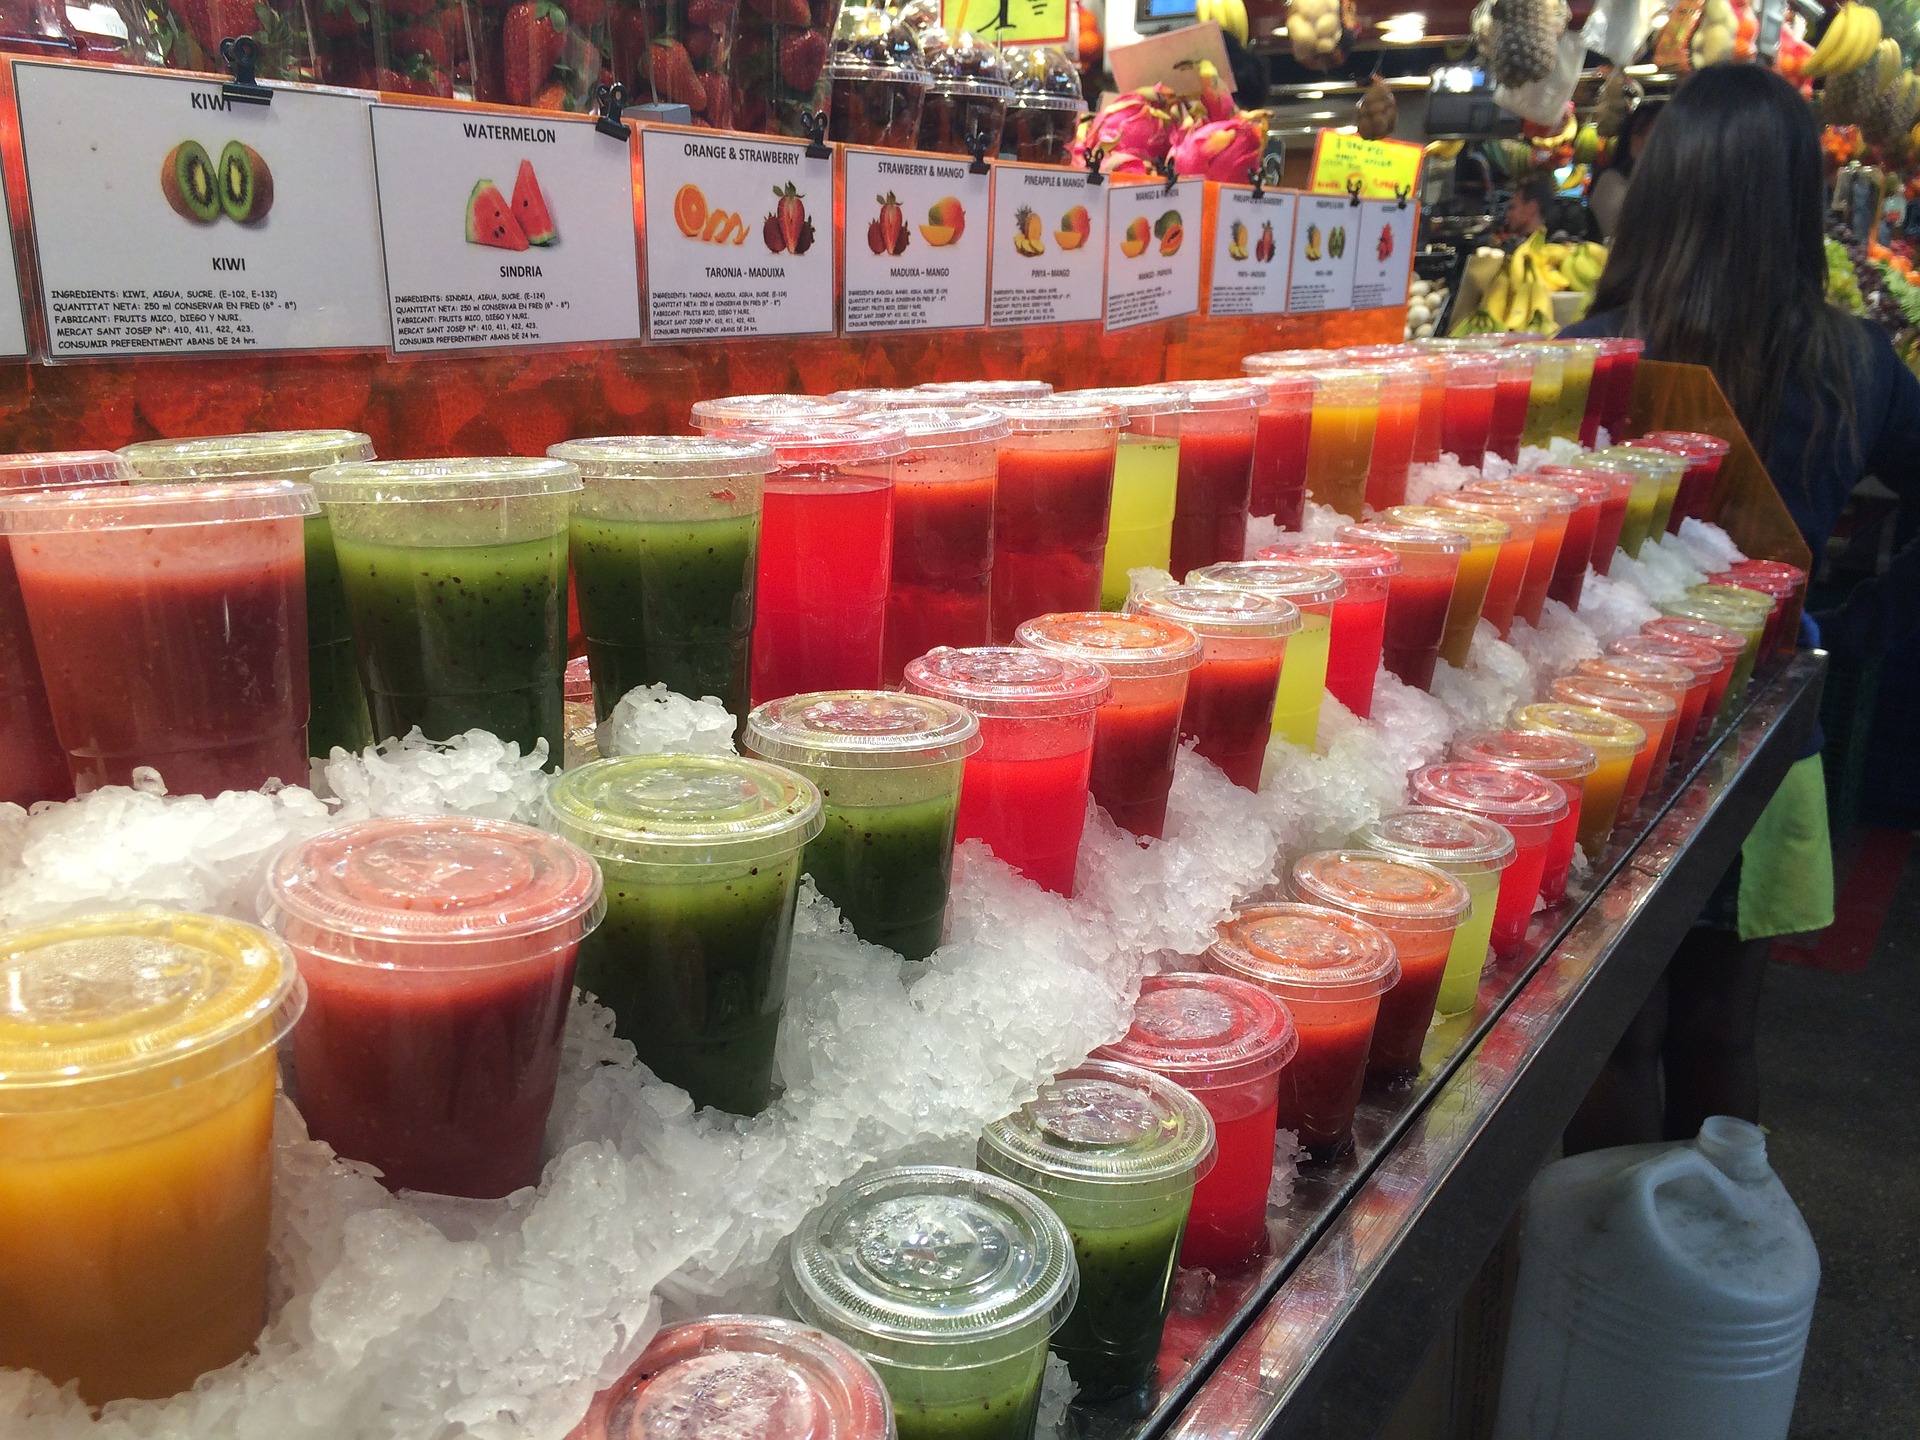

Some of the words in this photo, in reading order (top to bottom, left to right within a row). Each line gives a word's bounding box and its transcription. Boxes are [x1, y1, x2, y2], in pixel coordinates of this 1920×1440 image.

[464, 123, 556, 143] WATERMELON
[684, 143, 727, 160] ORANGE
[728, 148, 737, 160] &
[739, 149, 800, 166] STRAWBERRY
[878, 161, 928, 176] STRAWBERRY
[928, 165, 935, 177] &
[936, 166, 964, 179] MANGO
[212, 257, 246, 272] KIWI
[500, 265, 543, 278] SINDRIA
[705, 267, 742, 279] TARONJA
[748, 267, 785, 279] MADUIXA
[890, 268, 920, 277] MADUIXA
[926, 268, 950, 277] MANGO
[52, 290, 119, 299] INGREDIENTS:
[123, 290, 149, 299] KIWI,
[153, 290, 183, 299] AIGUA,
[187, 290, 215, 298] SUCRE.
[219, 290, 249, 299] (E-102,
[252, 290, 277, 299] E-132)
[53, 302, 109, 312] QUANTITAT
[113, 302, 140, 311] NETA:
[163, 302, 171, 310] ml
[174, 302, 223, 310] CONSERVAR
[226, 302, 238, 310] EN
[240, 302, 260, 310] FRED
[55, 315, 110, 324] FABRICANT:
[151, 314, 176, 323] MICO,
[180, 314, 206, 322] DIEGO
[218, 314, 241, 322] NURI.
[57, 328, 92, 336] MERCAT
[97, 327, 121, 335] SANT
[125, 327, 152, 335] JOSEP
[174, 326, 191, 335] 410,
[195, 326, 212, 334] 411,
[216, 325, 233, 334] 422,
[236, 325, 254, 333] 423.
[58, 340, 108, 349] CONSUMIR
[111, 339, 183, 347] PREFERENTMENT
[187, 338, 214, 346] ABANS
[217, 337, 228, 345] DE
